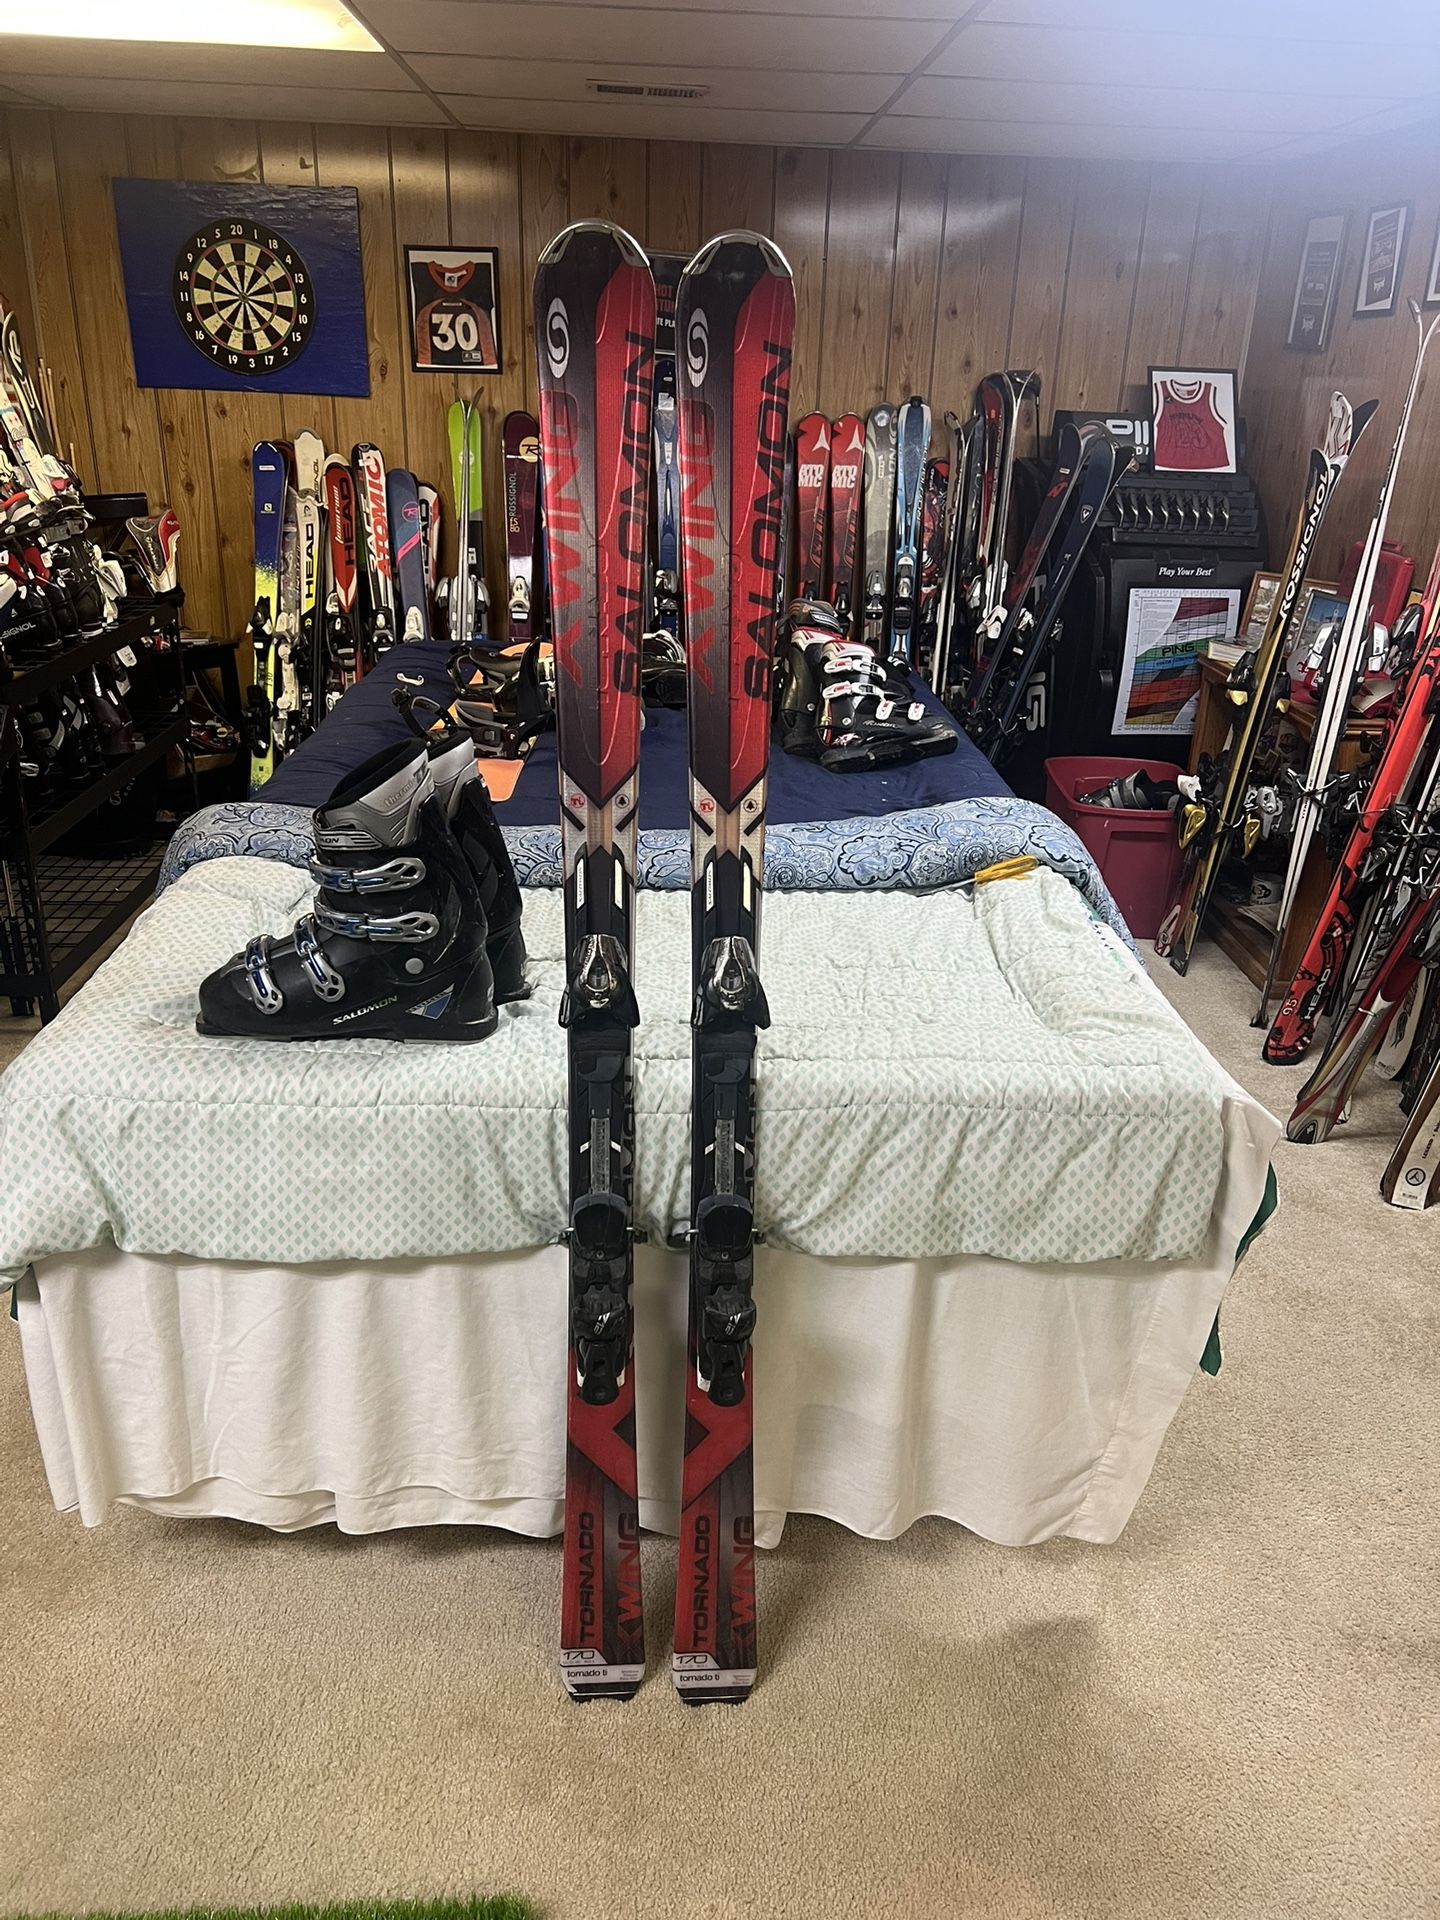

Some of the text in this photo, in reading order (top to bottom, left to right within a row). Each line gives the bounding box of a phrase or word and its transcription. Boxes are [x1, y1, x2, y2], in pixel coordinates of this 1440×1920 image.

[215, 229, 221, 238] 5
[230, 225, 243, 235] 20
[254, 229, 258, 239] 1
[197, 238, 207, 248] 12
[269, 240, 278, 249] 18
[187, 253, 193, 262] 9
[285, 255, 292, 264] 4
[179, 271, 189, 281] 14
[295, 273, 304, 283] 13
[180, 292, 189, 301] 11
[300, 294, 307, 303] 6
[186, 313, 193, 322] 8
[299, 314, 308, 324] 10
[195, 330, 205, 340] 16
[292, 332, 301, 342] 15
[431, 313, 478, 351] 30
[211, 345, 218, 354] 7
[282, 346, 289, 355] 2
[228, 355, 238, 364] 19
[249, 358, 255, 368] 3
[264, 355, 274, 365] 17
[800, 464, 824, 477] ATO
[833, 464, 857, 478] ATO
[798, 475, 823, 488] MIC
[832, 476, 855, 488] MIC
[509, 472, 517, 516] ROSSIGNOL
[365, 455, 391, 578] ATOMIC
[614, 329, 654, 697] SALOMON
[339, 478, 354, 566] HEAD
[743, 340, 792, 701] SALOMON
[1279, 470, 1328, 620] ROSSIGNOL
[305, 523, 315, 599] HEAD
[1159, 566, 1212, 578] Play Your Best
[0, 622, 36, 639] SIGNOL
[1162, 643, 1195, 656] PING
[1304, 968, 1331, 1019] HEAD
[332, 995, 398, 1025] SALOMON
[578, 1512, 595, 1643] TORNADO
[693, 1515, 710, 1647] TORNADO
[563, 1650, 595, 1660] 170
[676, 1655, 708, 1664] 170
[567, 1669, 601, 1677] tornado
[680, 1673, 720, 1682] tornado ti
